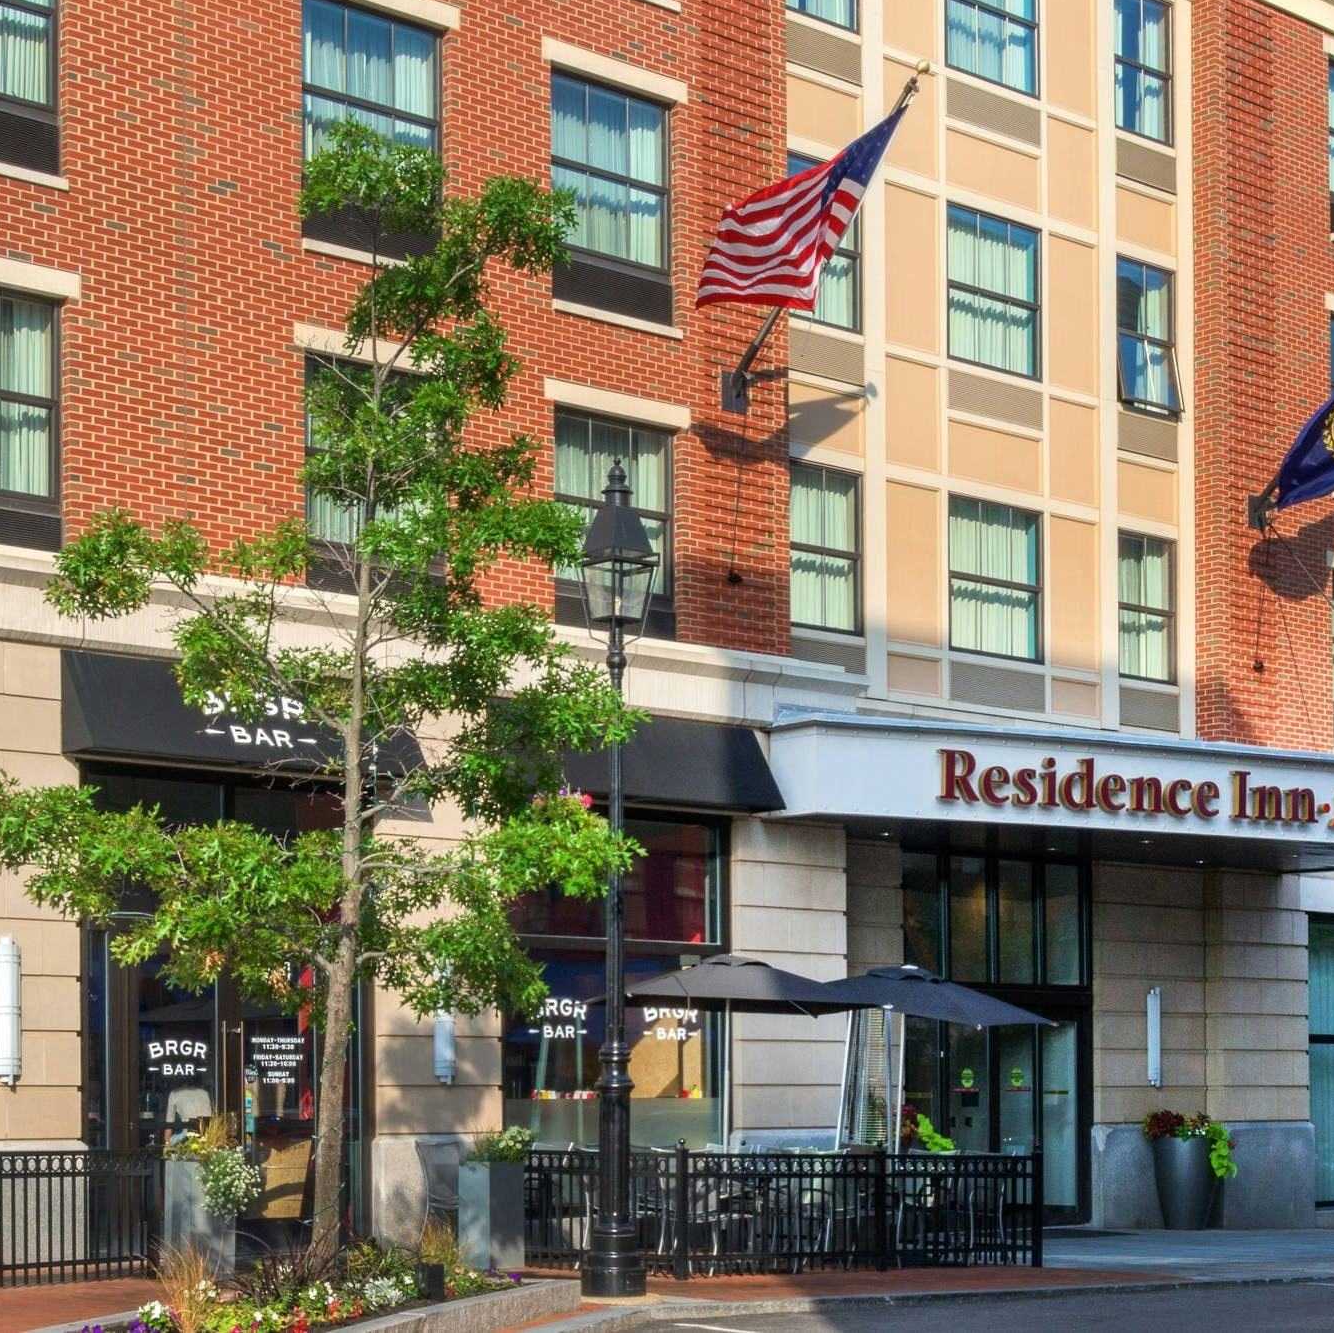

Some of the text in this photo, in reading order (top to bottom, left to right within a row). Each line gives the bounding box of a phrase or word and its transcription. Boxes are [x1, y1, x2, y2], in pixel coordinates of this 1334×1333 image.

[204, 689, 307, 724] BR
[229, 725, 294, 748] BAR
[935, 748, 1220, 818] Residence
[1228, 770, 1319, 824] Inn
[535, 998, 588, 1020] RGR
[543, 1025, 575, 1039] BAR
[656, 1027, 687, 1041] BAR
[148, 1039, 208, 1059] BRGR
[163, 1064, 195, 1076] BAR
